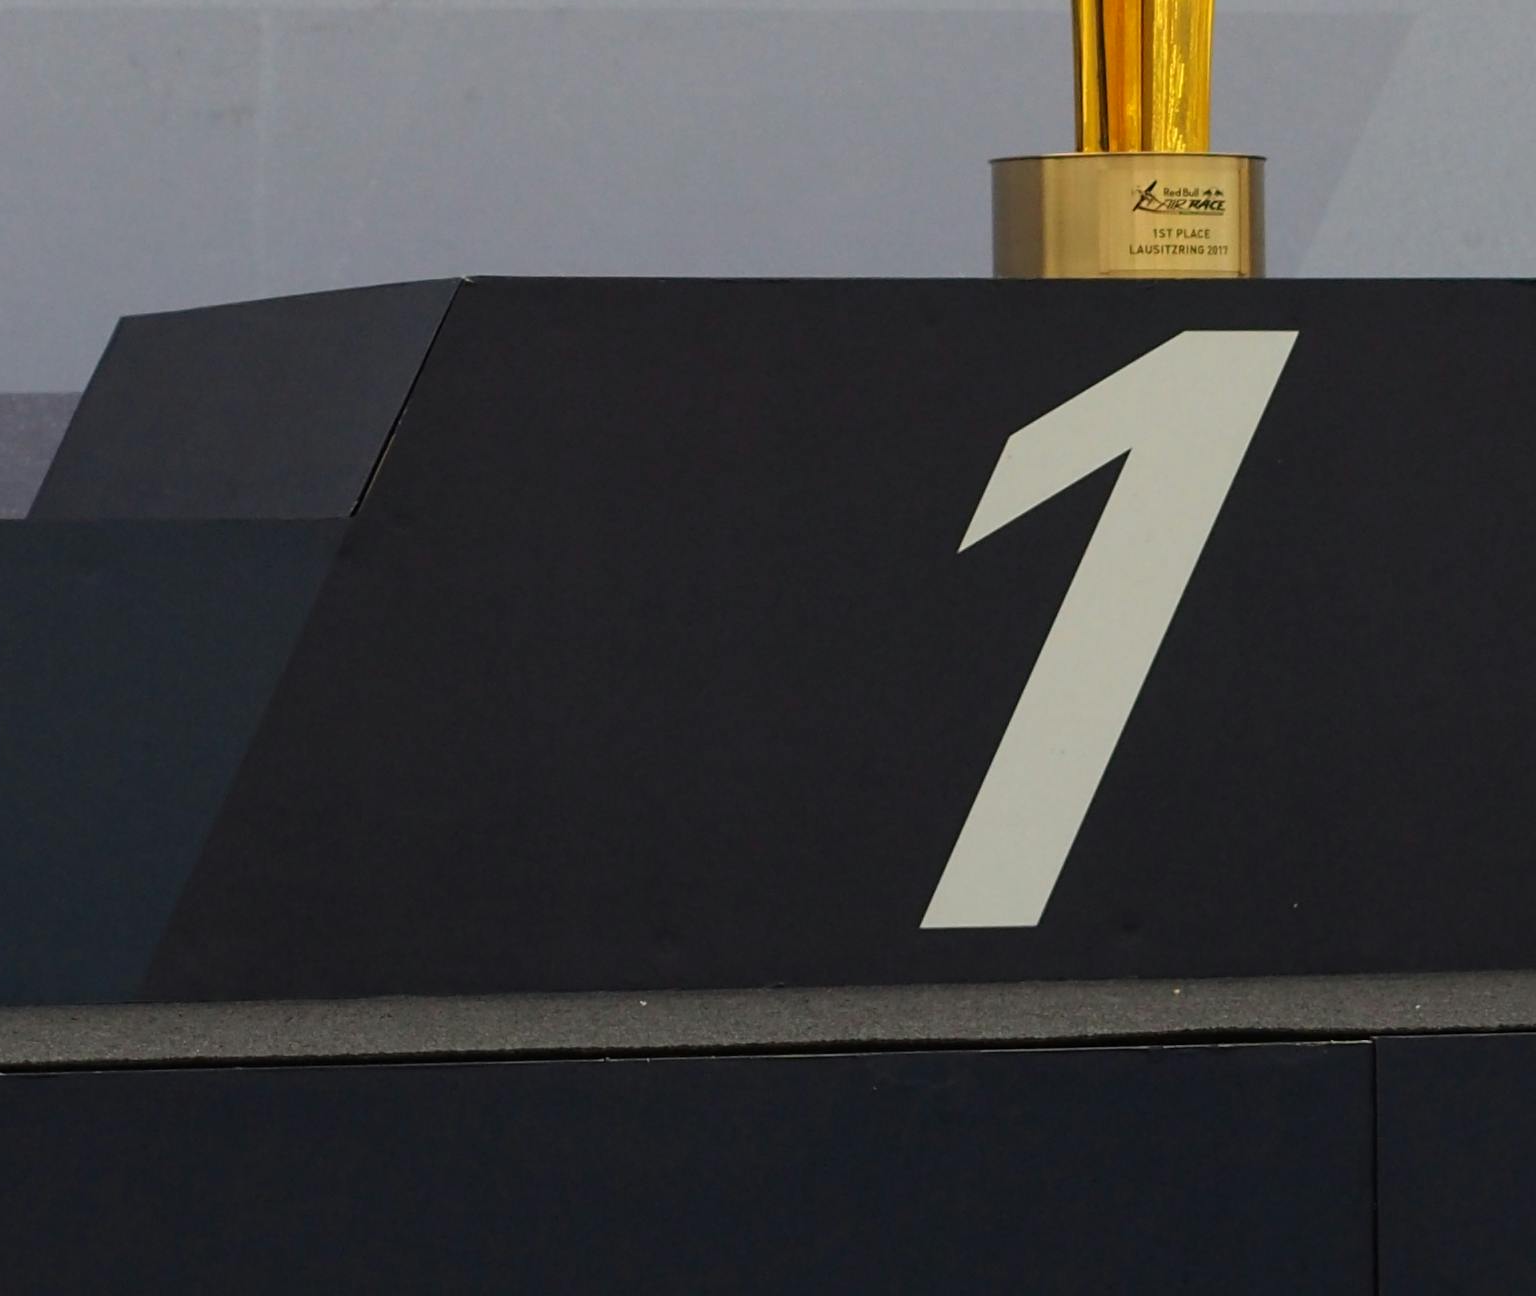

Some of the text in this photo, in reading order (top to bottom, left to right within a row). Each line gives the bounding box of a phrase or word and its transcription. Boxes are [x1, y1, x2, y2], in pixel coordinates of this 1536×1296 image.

[1163, 187, 1199, 197] Red Bull
[1189, 199, 1226, 211] RACE
[1153, 228, 1211, 239] 1ST PLACE
[1129, 244, 1229, 255] LAUSITZRING 2017
[920, 331, 1300, 929] 1
